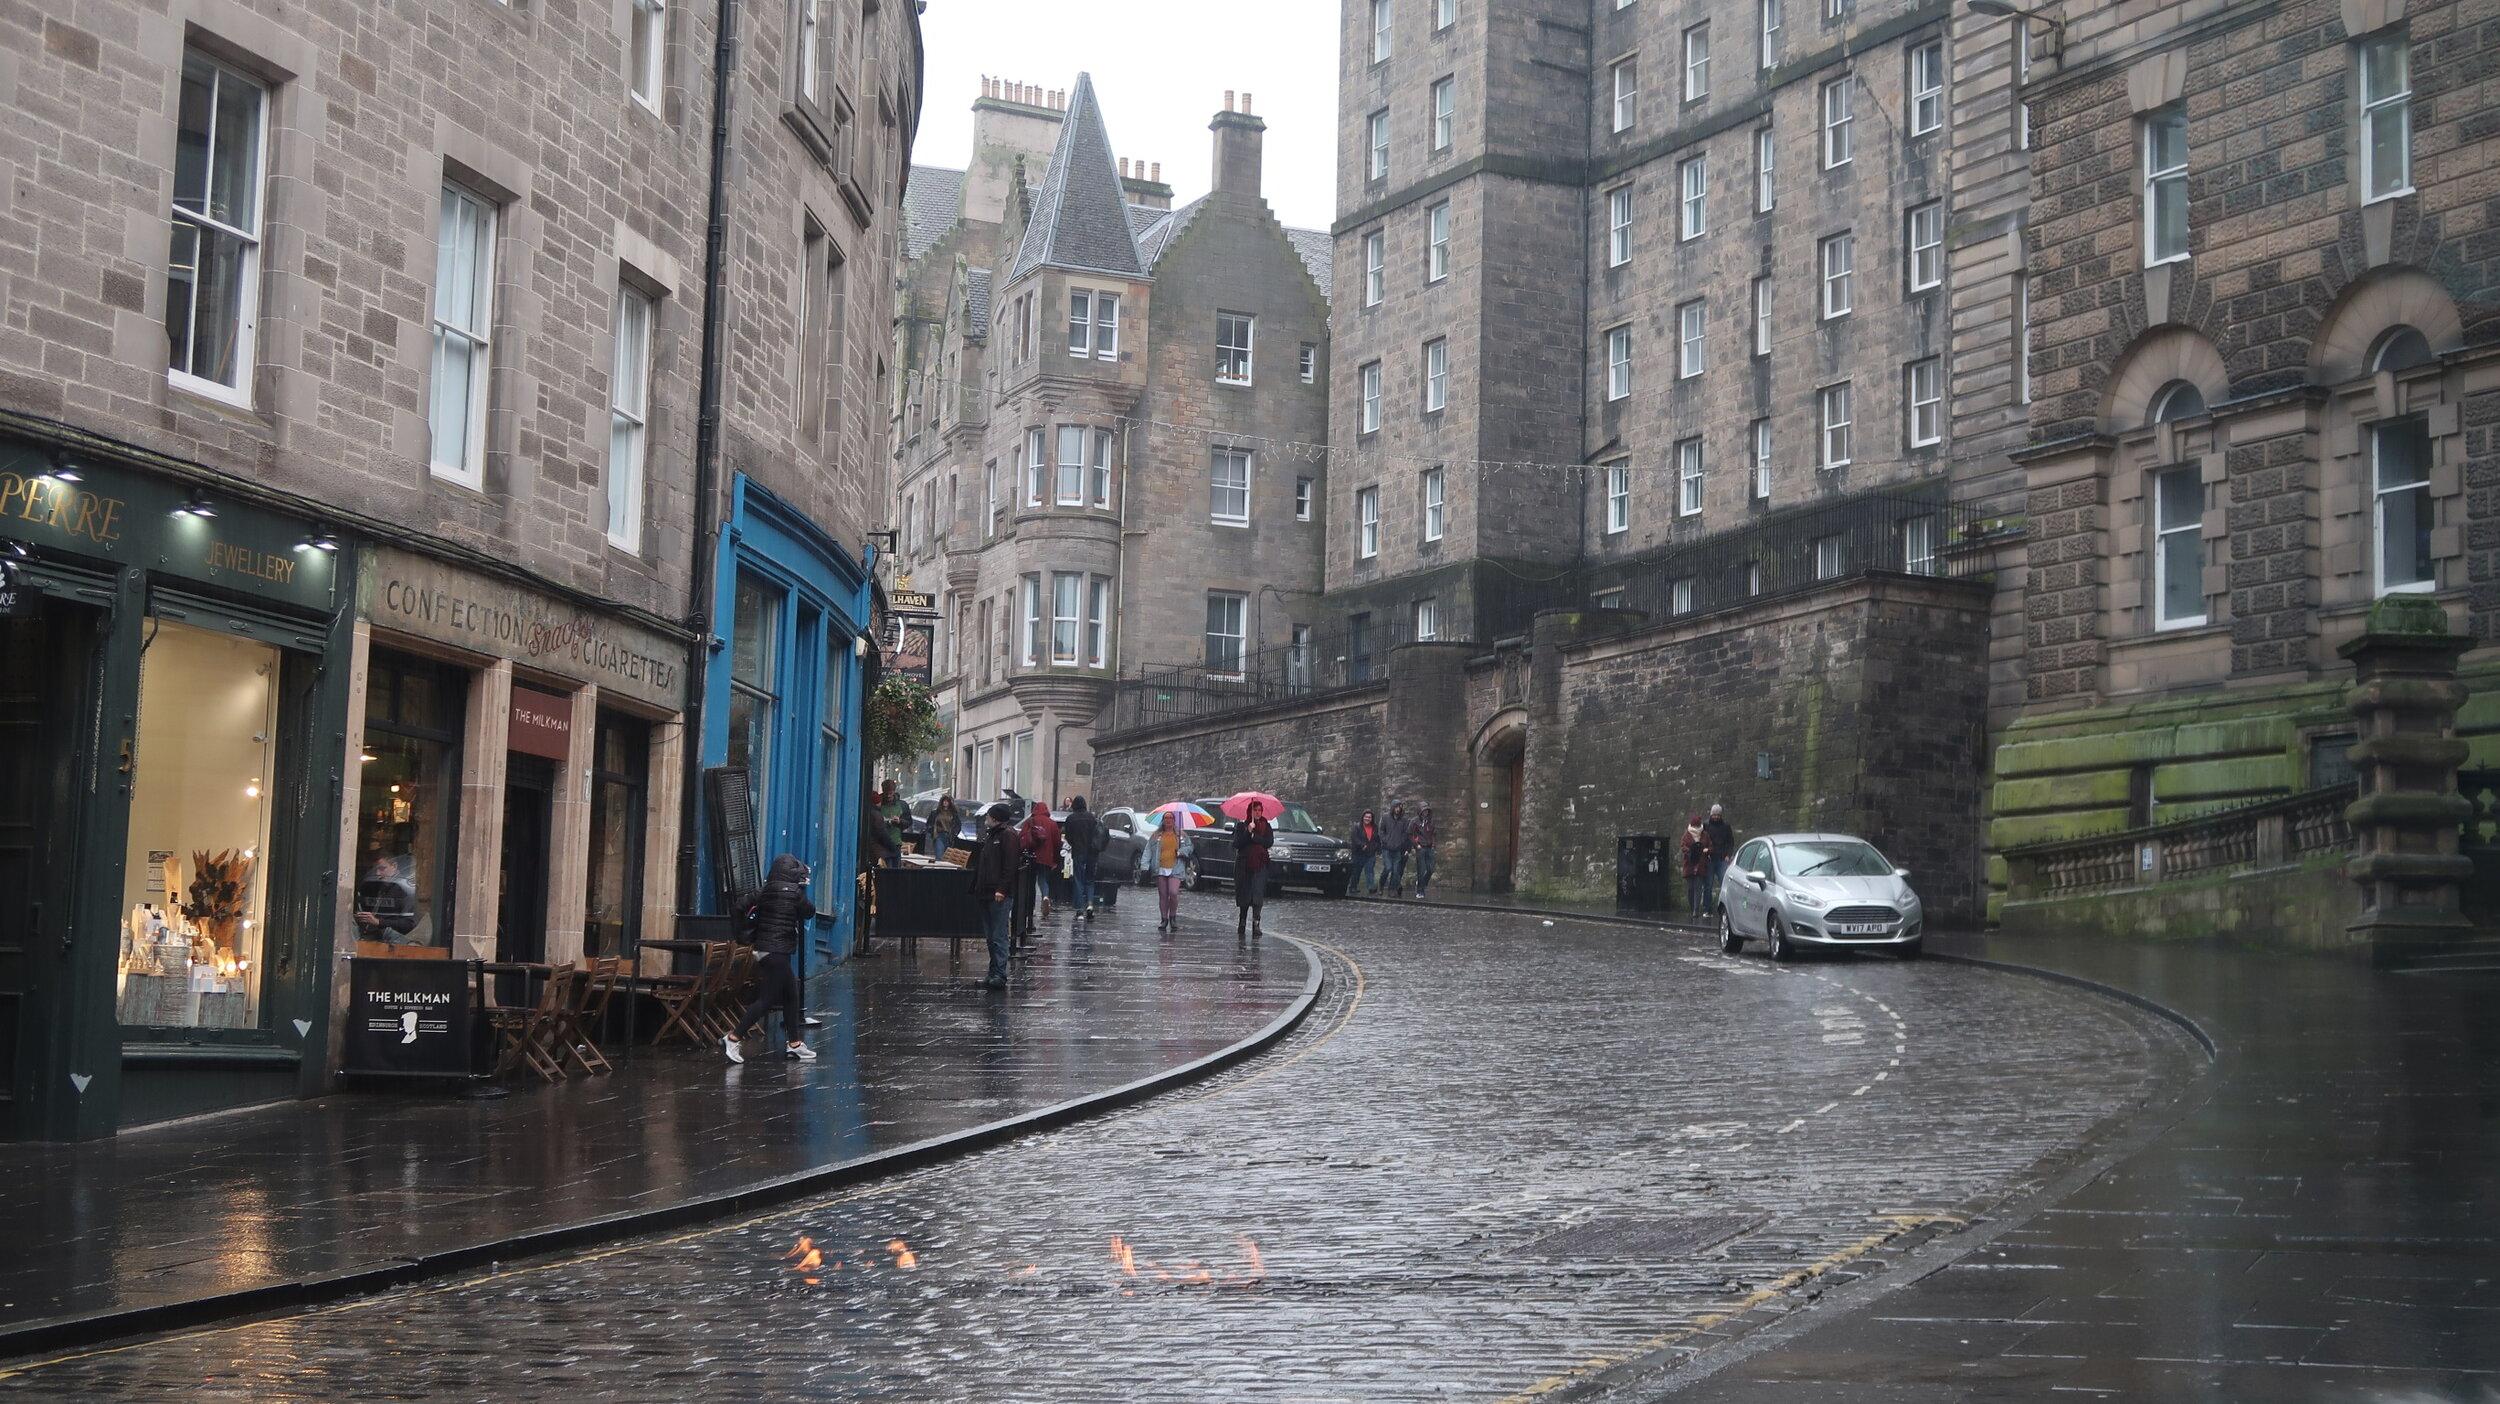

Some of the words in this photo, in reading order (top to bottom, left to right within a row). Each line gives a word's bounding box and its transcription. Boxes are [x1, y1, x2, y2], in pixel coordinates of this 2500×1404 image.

[205, 540, 295, 584] JEWELLERY
[892, 594, 928, 607] LHAVEN
[515, 708, 531, 724] THE
[532, 714, 568, 731] MILKMAN
[367, 991, 391, 1003] THE
[394, 992, 450, 1004] MILKMAN
